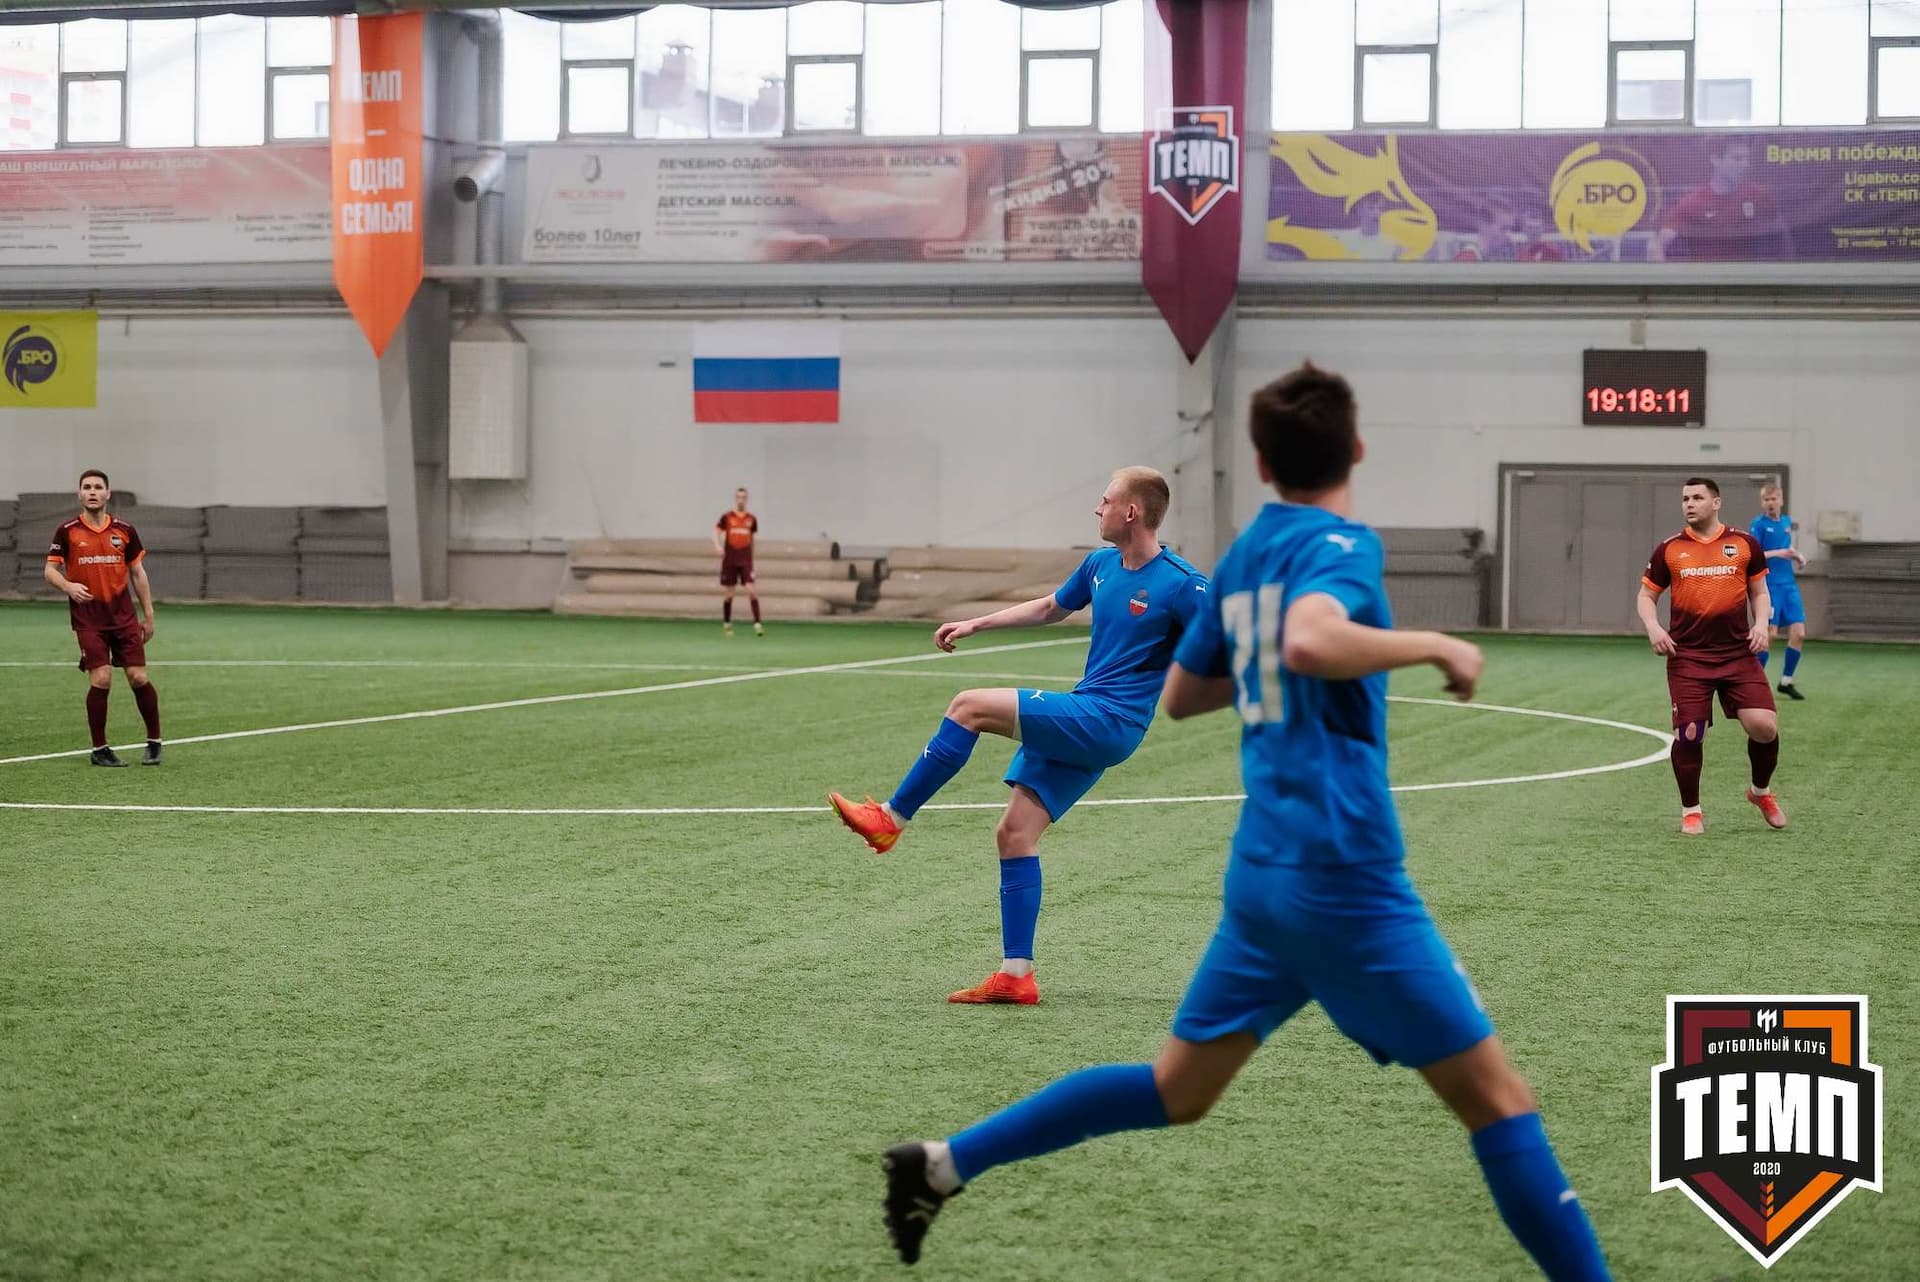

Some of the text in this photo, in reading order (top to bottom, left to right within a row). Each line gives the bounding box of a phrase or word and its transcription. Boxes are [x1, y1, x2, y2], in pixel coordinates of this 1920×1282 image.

[1158, 139, 1230, 180] ТЕМП
[1766, 141, 1920, 165] Время побежд
[349, 158, 405, 194] ОДНА
[657, 193, 726, 208] ДЕТСКИЙ
[342, 201, 413, 235] СЕМЬЯ!
[535, 227, 587, 242] более
[1587, 387, 1690, 413] 19:18:11
